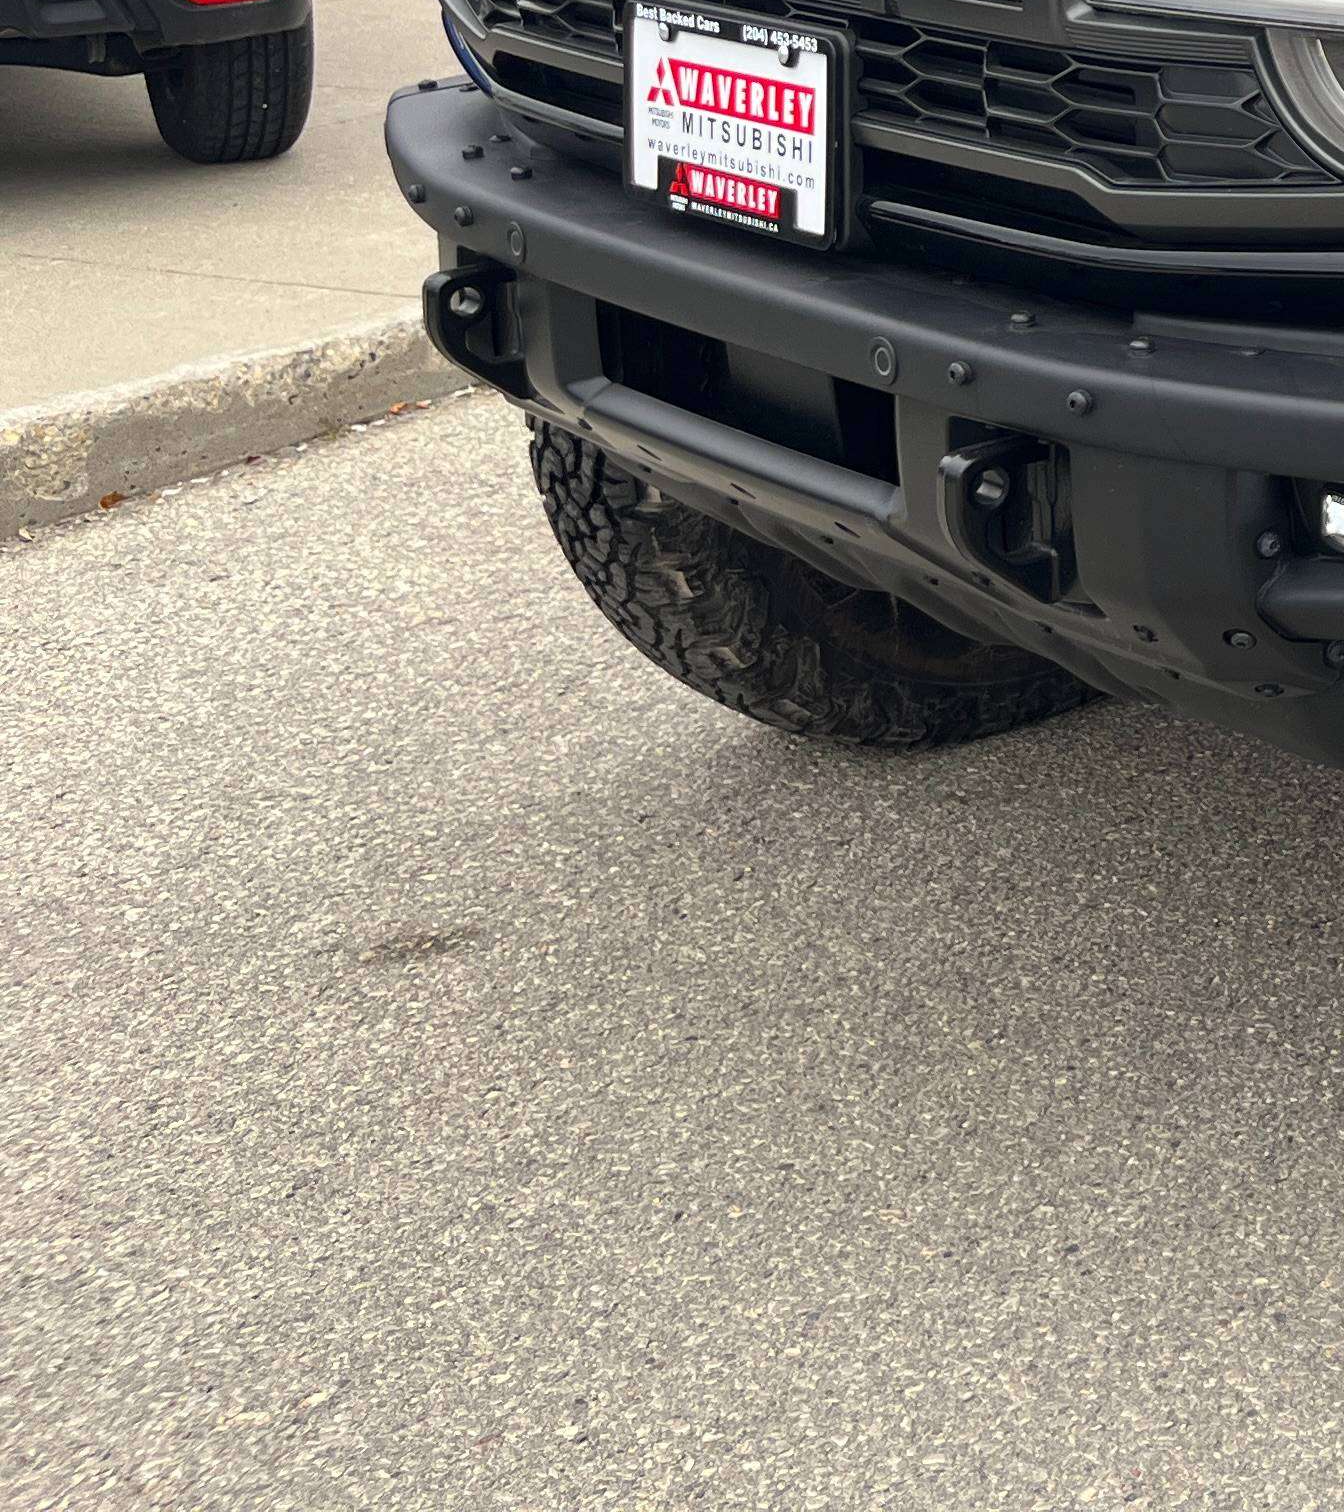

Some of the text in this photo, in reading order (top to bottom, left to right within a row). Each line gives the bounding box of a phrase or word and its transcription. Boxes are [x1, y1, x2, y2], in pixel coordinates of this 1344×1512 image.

[636, 3, 818, 52] Best Backed Cars (204) 453-5453
[678, 66, 815, 128] WAVERLEY
[682, 111, 814, 163] MITSUBISHI
[647, 137, 815, 190] waverleymitsubishi.com
[690, 168, 778, 215] WAVERLEY
